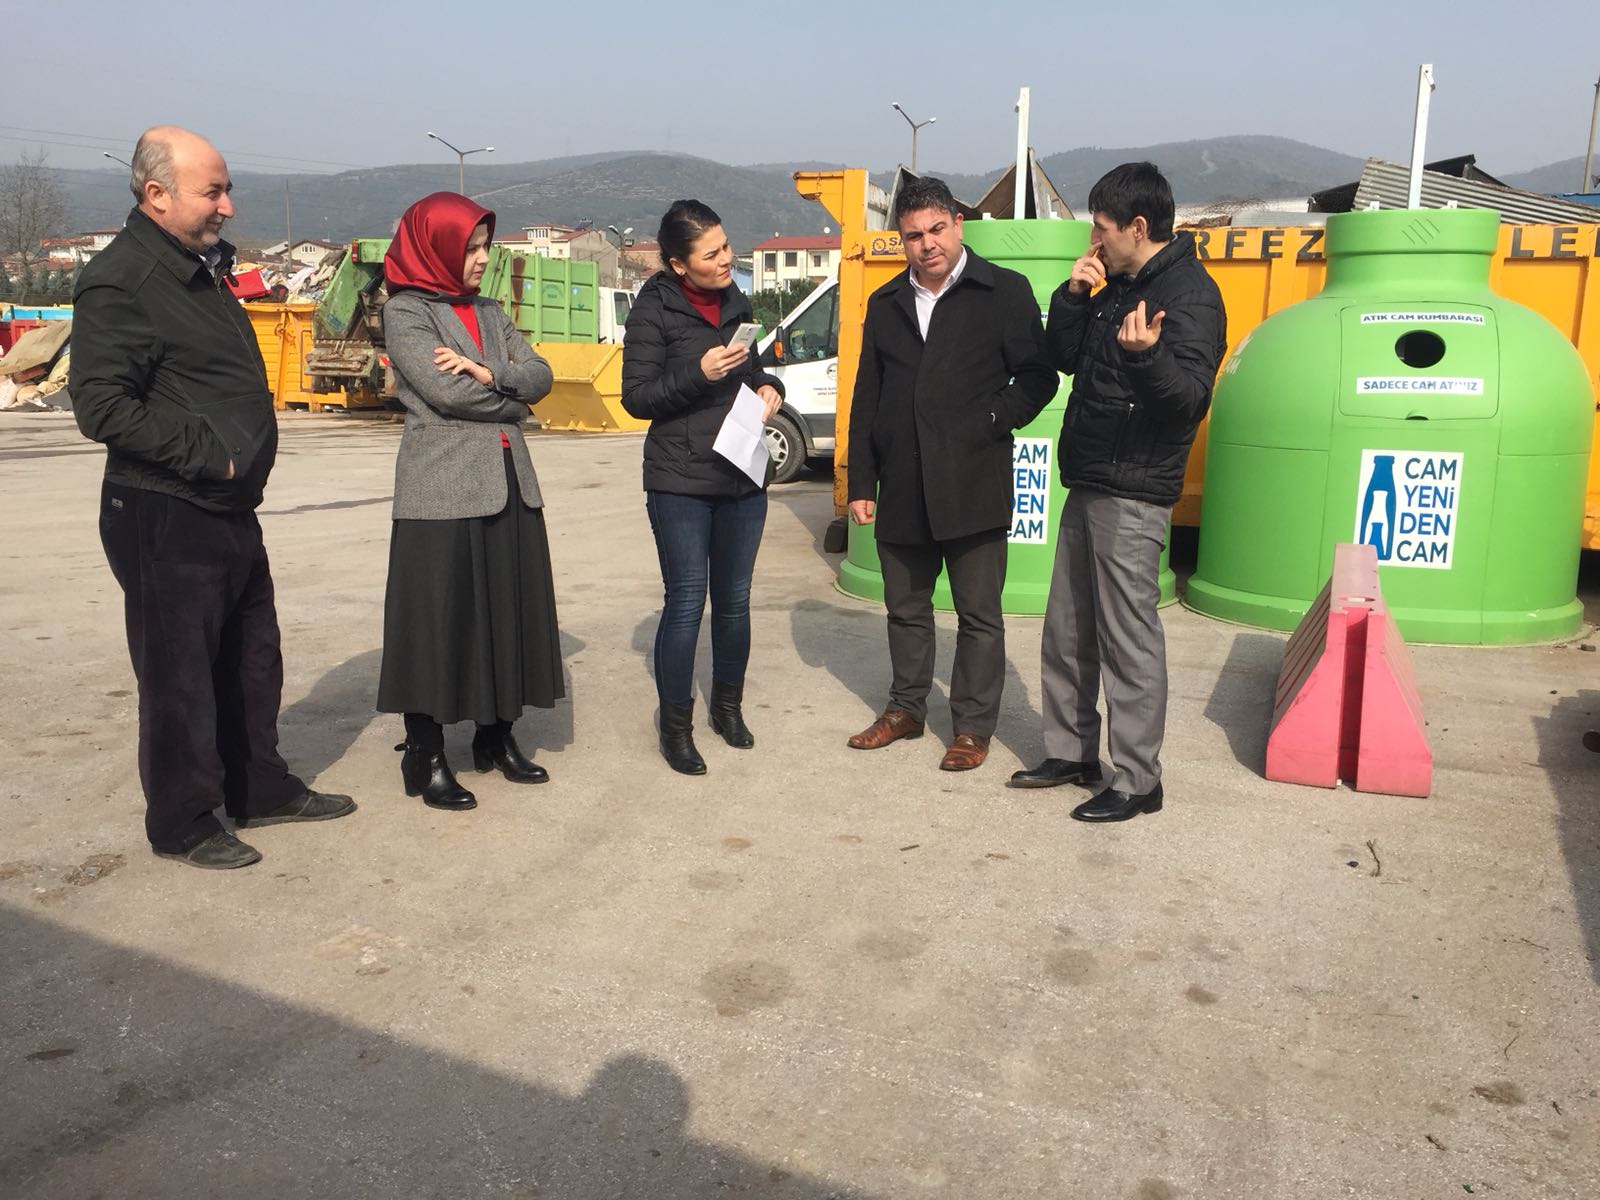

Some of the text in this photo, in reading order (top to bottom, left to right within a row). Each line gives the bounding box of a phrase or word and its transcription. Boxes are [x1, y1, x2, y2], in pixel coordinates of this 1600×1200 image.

[1417, 314, 1483, 322] KUMBARASI
[1363, 381, 1409, 390] SADECE
[1411, 381, 1437, 390] CAM
[1405, 457, 1457, 480] CAM
[1399, 512, 1451, 536] DEN
[1396, 540, 1448, 563] CAM
